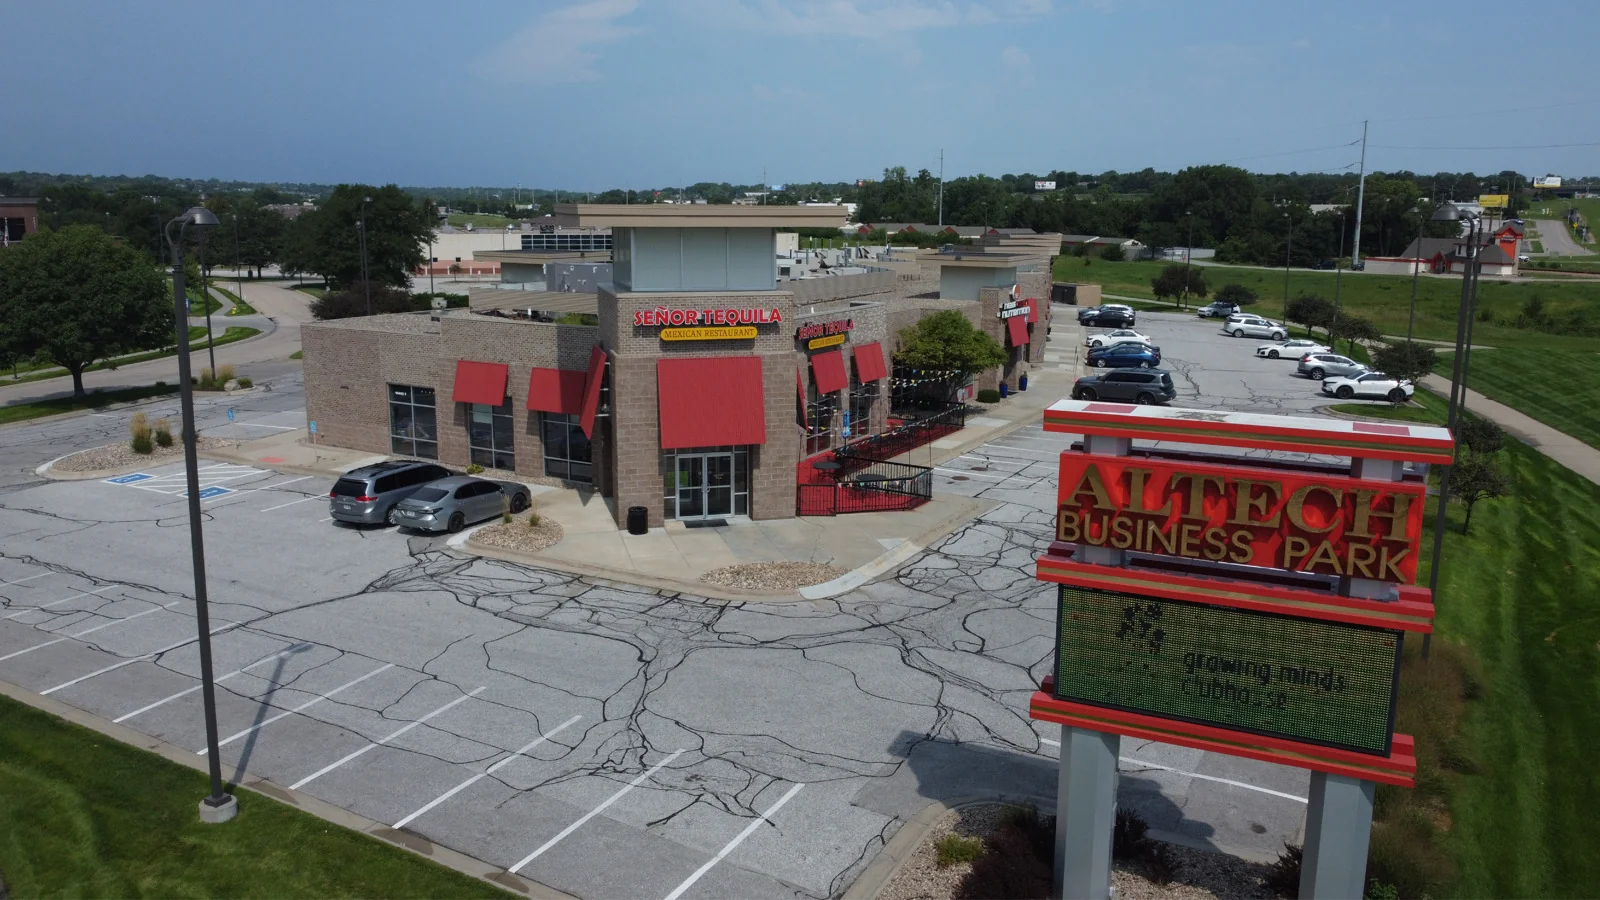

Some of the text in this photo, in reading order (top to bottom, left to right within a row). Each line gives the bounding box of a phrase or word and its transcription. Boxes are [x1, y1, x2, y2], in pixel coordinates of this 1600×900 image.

[634, 306, 782, 326] SEÑOR TEQUILA
[825, 319, 855, 335] TEQUILA
[664, 328, 755, 339] MEXICAN RESTAURANT
[1060, 463, 1419, 543] ALTECH
[1058, 510, 1412, 582] BUSINESS PARK
[1183, 652, 1345, 692] growing minds
